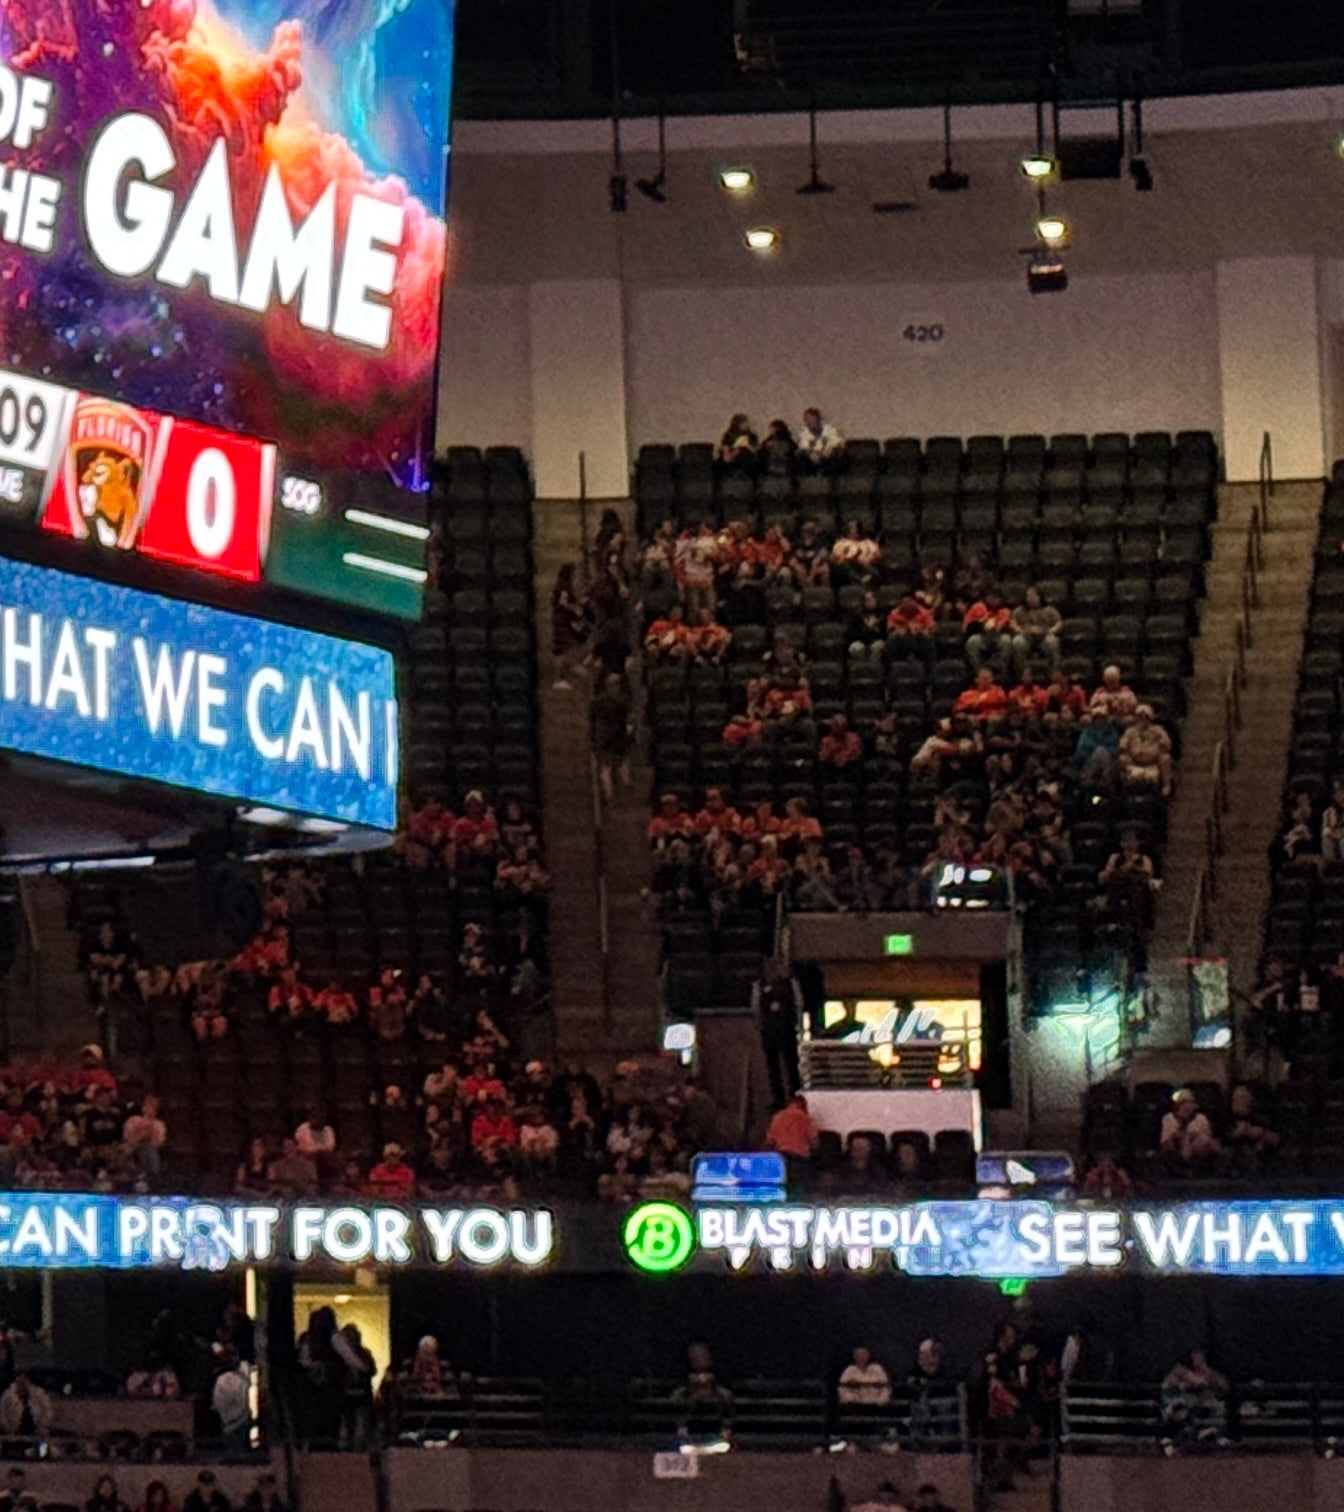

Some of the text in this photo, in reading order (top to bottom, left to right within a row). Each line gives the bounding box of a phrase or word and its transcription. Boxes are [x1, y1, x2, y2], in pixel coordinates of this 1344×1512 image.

[83, 111, 404, 350] GAME
[902, 324, 944, 342] 420
[186, 446, 236, 558] 0
[280, 475, 323, 515] SOG
[133, 635, 227, 746] WE
[246, 667, 371, 781] CAN
[293, 1208, 411, 1262] FOR
[422, 1208, 555, 1264] YOU
[700, 1208, 942, 1249] BLAST MEDIA
[1018, 1211, 1122, 1267] SEE
[1132, 1212, 1315, 1269] WHAT
